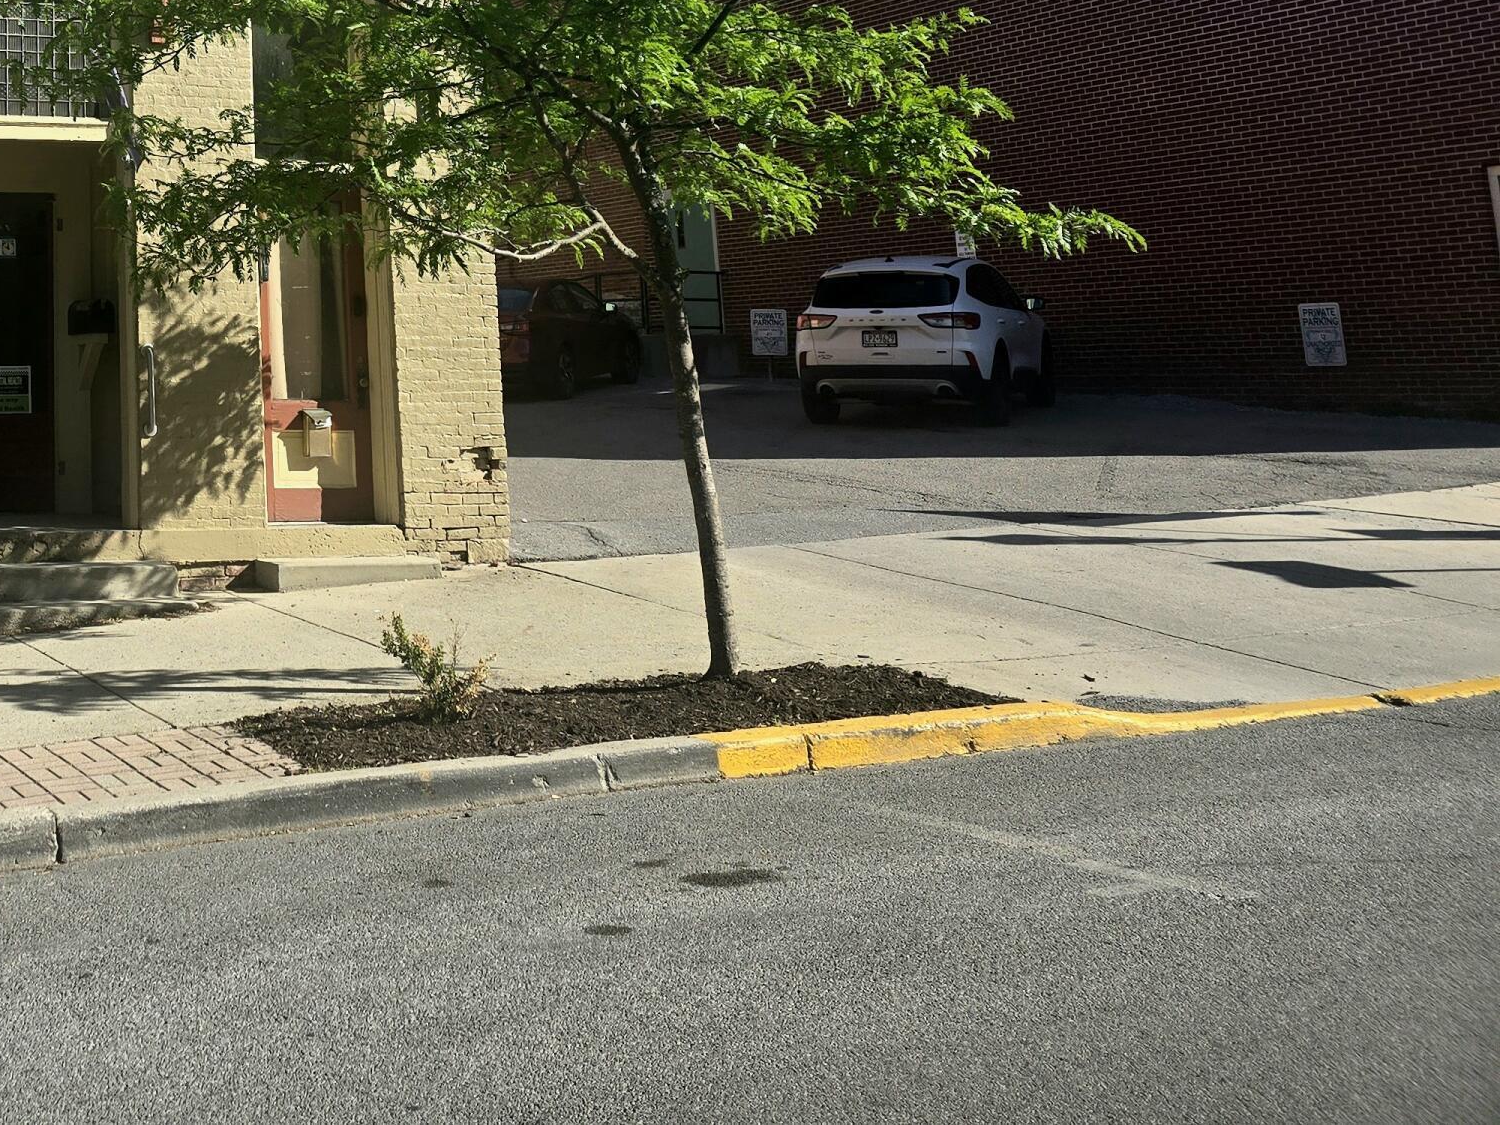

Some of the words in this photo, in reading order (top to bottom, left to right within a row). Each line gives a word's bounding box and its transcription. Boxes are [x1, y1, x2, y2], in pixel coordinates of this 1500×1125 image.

[754, 312, 783, 320] PRIVATE
[1302, 307, 1336, 317] PRIVATE
[1302, 316, 1340, 326] PARKING
